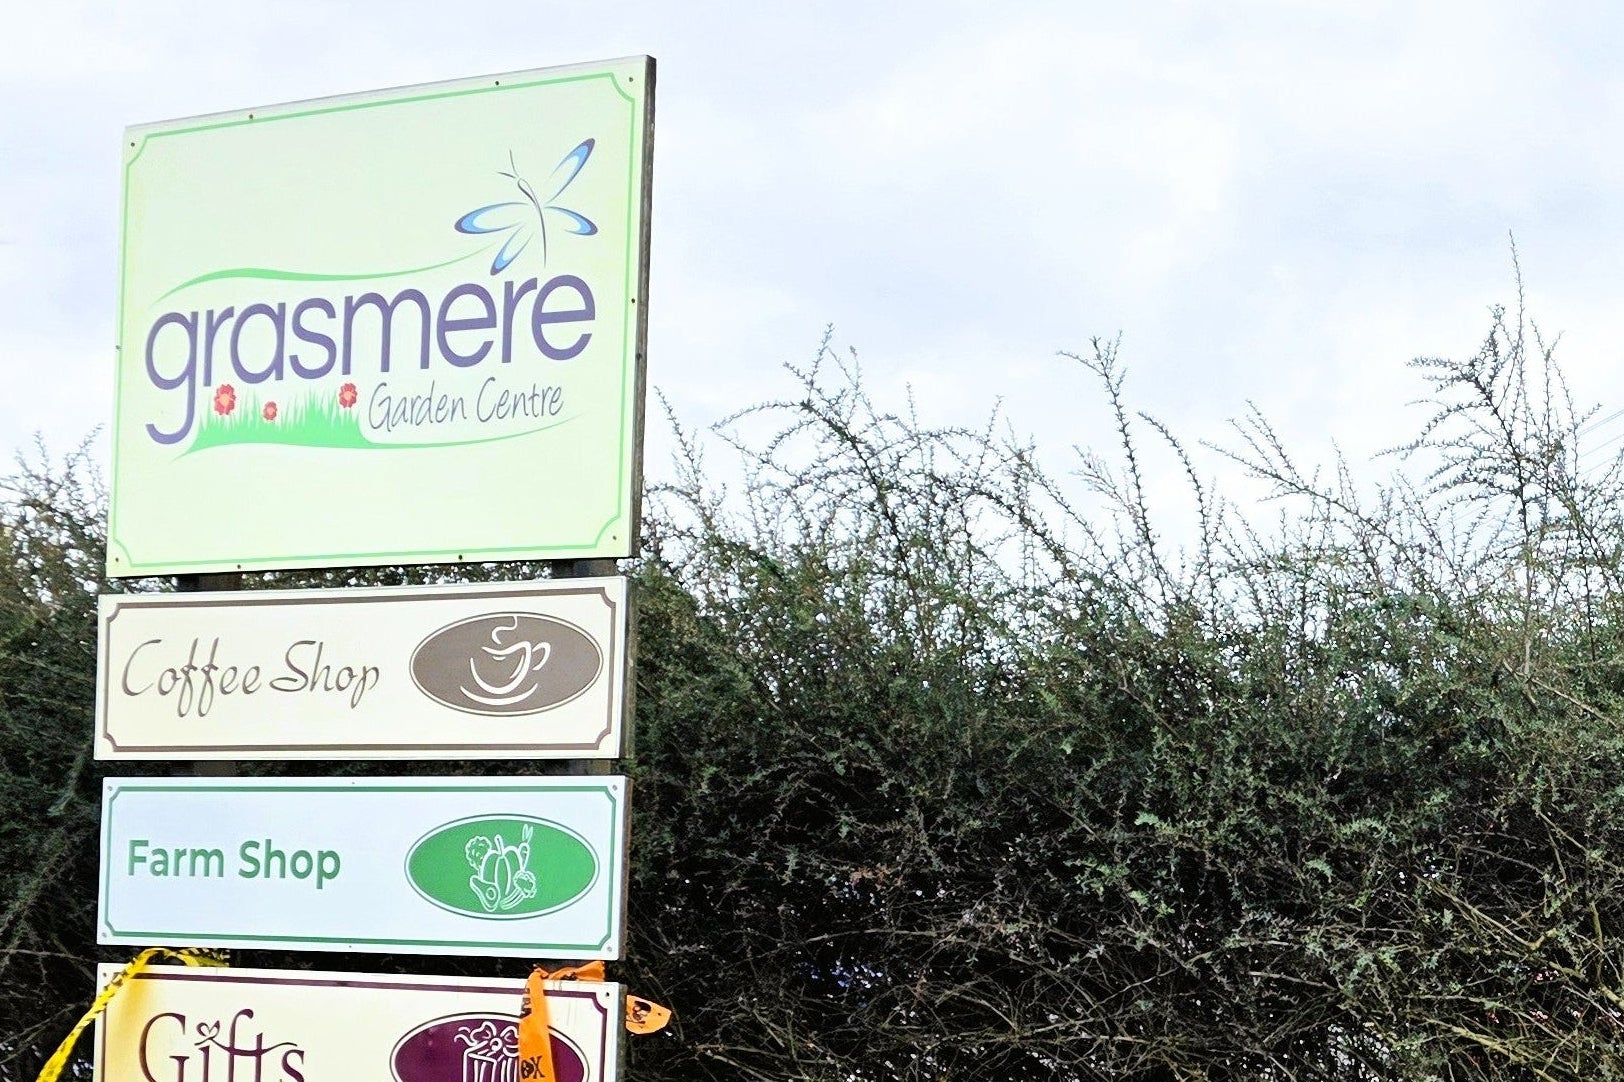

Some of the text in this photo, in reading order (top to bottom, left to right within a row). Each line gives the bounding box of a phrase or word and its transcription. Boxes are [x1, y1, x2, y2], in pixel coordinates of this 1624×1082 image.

[145, 274, 595, 444] grasmere
[368, 377, 564, 431] Garden Centre
[121, 636, 380, 718] Coffee Shop
[127, 838, 341, 889] Farm Shop
